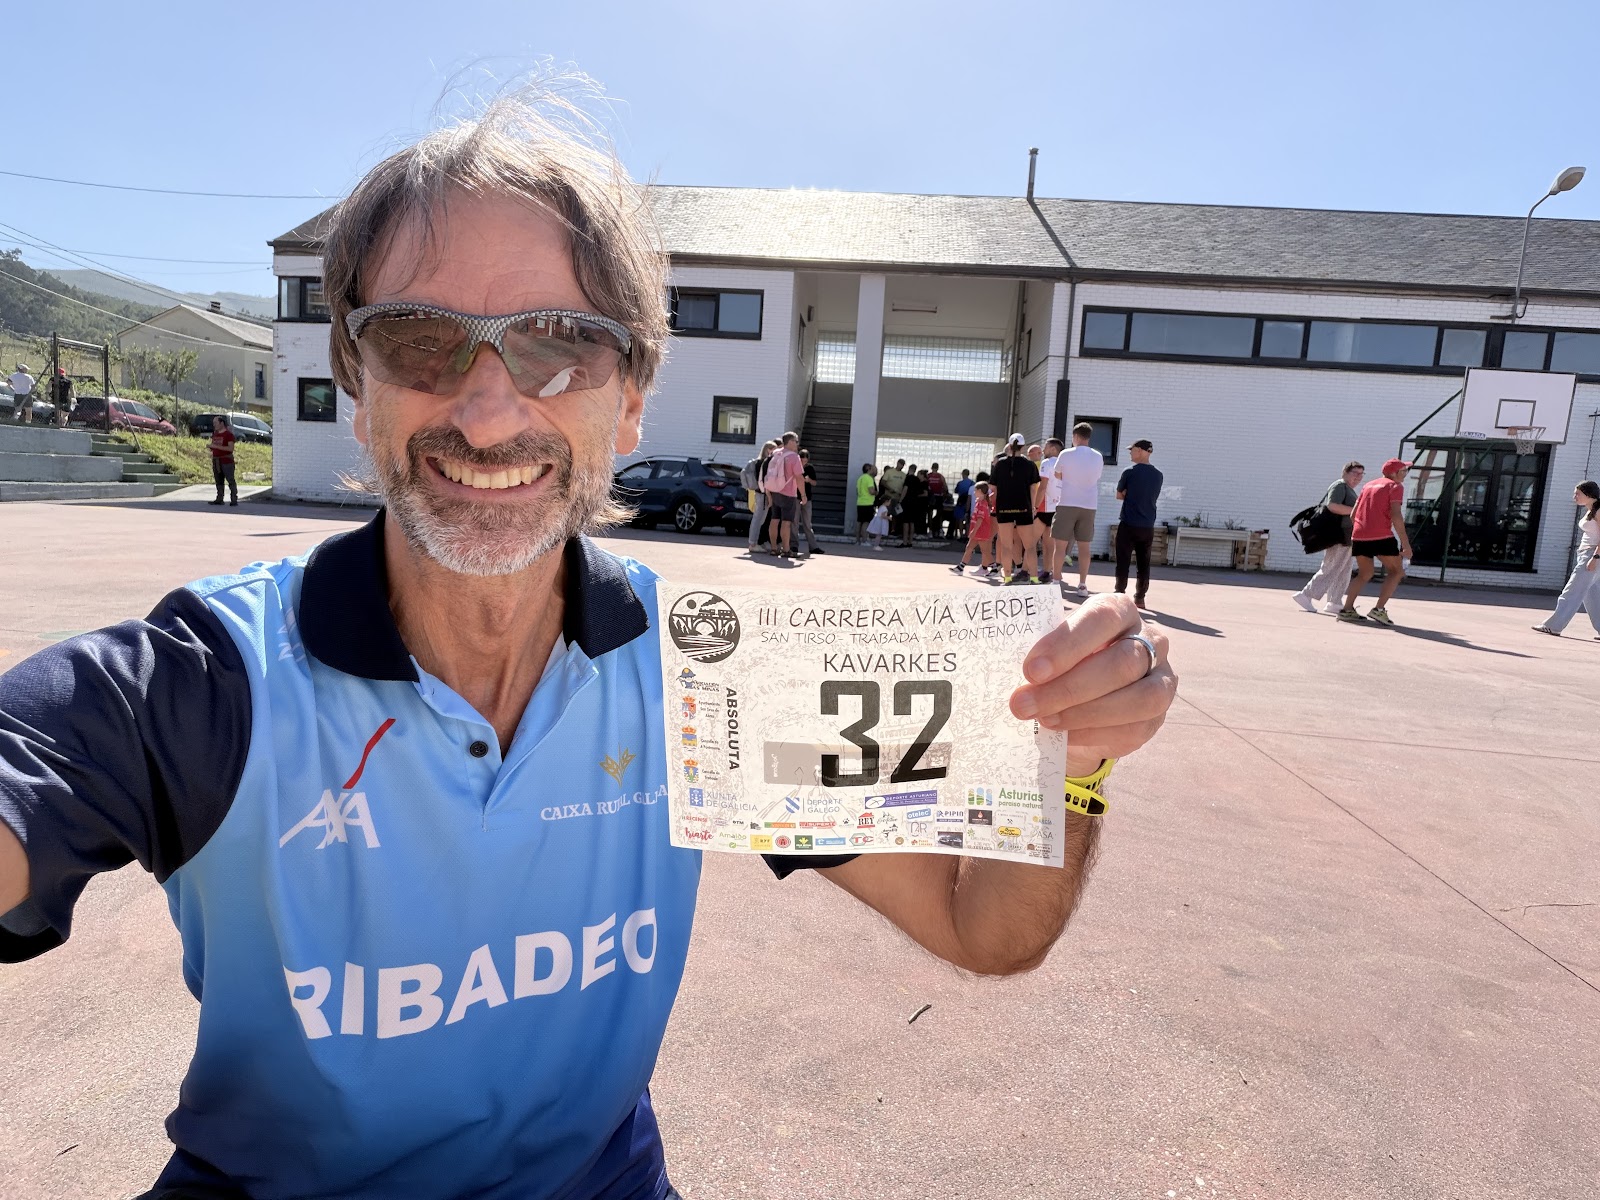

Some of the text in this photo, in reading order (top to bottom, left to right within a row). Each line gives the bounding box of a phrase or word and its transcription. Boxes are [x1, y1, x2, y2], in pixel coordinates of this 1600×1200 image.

[758, 597, 1036, 627] III CARRERA VÍA VERDE
[760, 631, 789, 643] SAN
[932, 631, 944, 642] A
[949, 623, 1033, 641] PONTENOVA
[823, 652, 957, 673] KAVARKES
[726, 687, 740, 770] ABSOLUTA
[820, 679, 953, 788] 32
[706, 790, 738, 801] XUNTA
[998, 787, 1044, 802] Asturias
[540, 802, 594, 821] CAIXA
[720, 800, 758, 812] GALICIA
[807, 806, 841, 814] GALEGO
[279, 788, 382, 850] AXA
[858, 816, 875, 826] REY
[283, 907, 658, 1040] RIBADEO
